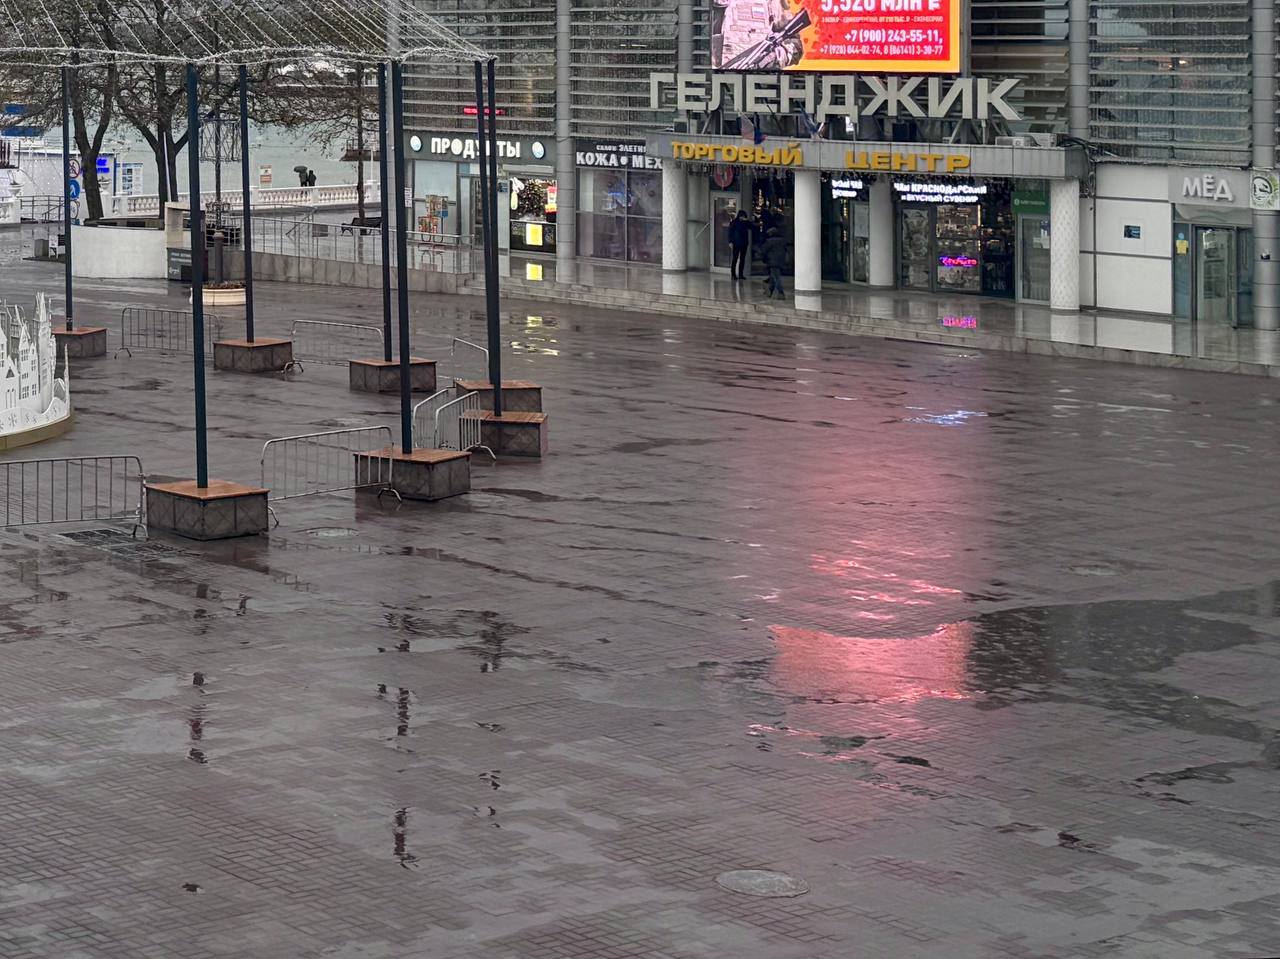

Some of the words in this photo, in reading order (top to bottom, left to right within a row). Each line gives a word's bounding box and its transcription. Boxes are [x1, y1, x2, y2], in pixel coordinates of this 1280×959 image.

[845, 29, 858, 42] +7
[859, 28, 886, 44] (900)
[888, 29, 943, 44] 243-55-11,
[650, 72, 1022, 123] ГЕЛЕНДЖИК
[576, 151, 619, 167] КОЖА
[672, 141, 804, 166] ТОРГОВЫЙ
[844, 149, 971, 173] ЦЕНТР
[1183, 173, 1233, 202] МЁД
